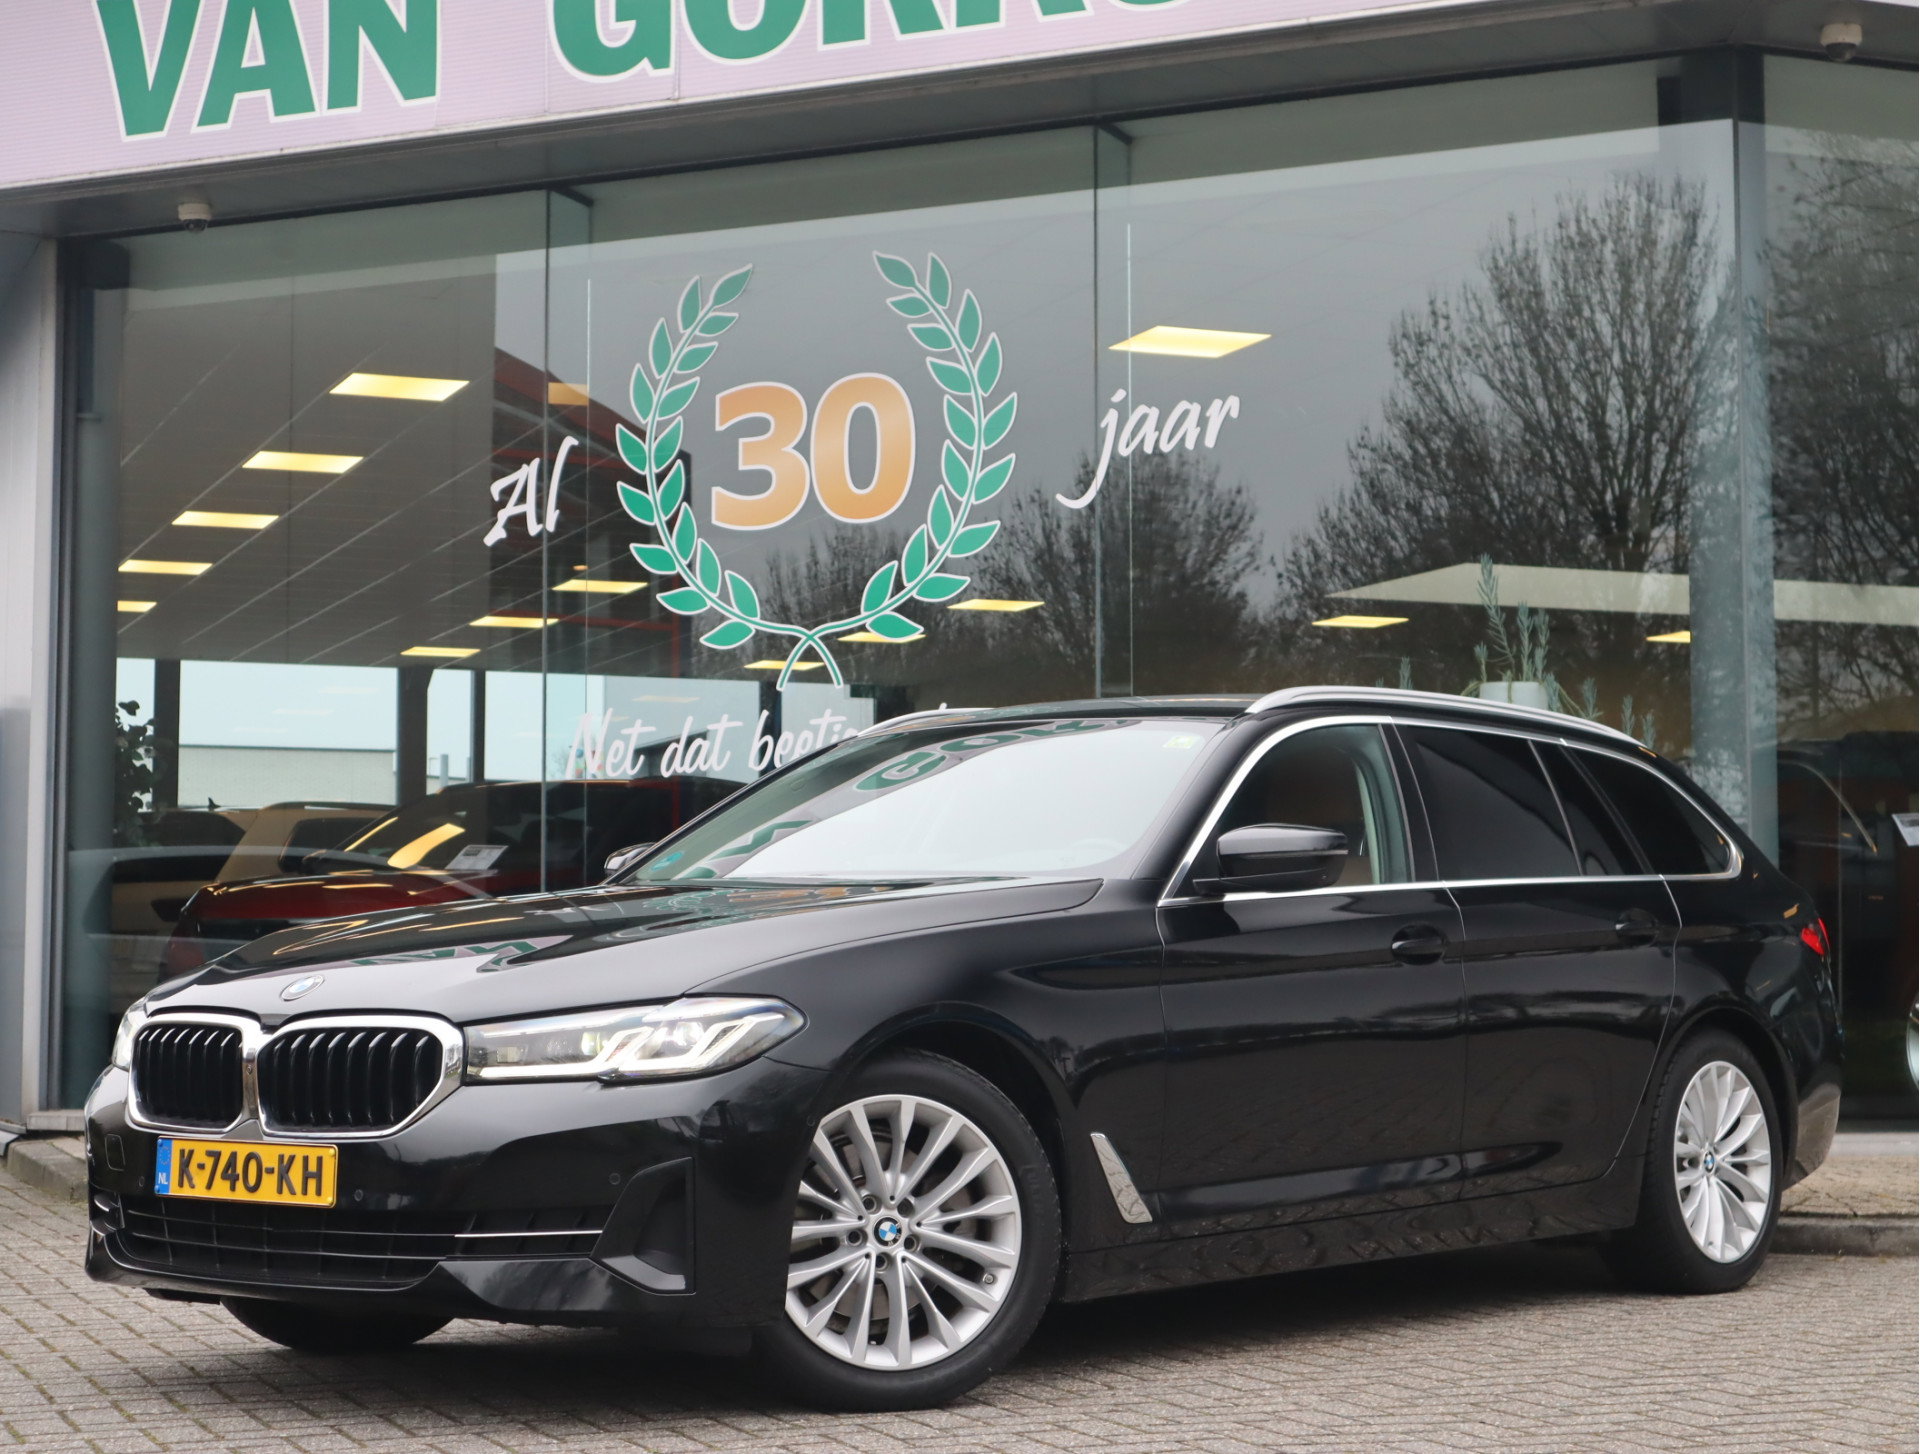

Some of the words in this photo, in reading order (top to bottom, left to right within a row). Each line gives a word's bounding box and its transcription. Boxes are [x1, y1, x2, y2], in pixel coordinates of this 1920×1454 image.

[94, 0, 441, 141] VAN
[483, 436, 577, 547] Al
[711, 372, 916, 531] 30
[1055, 388, 1240, 509] jaar
[565, 707, 657, 778] Net
[660, 713, 742, 778] dat
[158, 1172, 168, 1185] NL
[178, 1148, 323, 1197] K-740-KH
